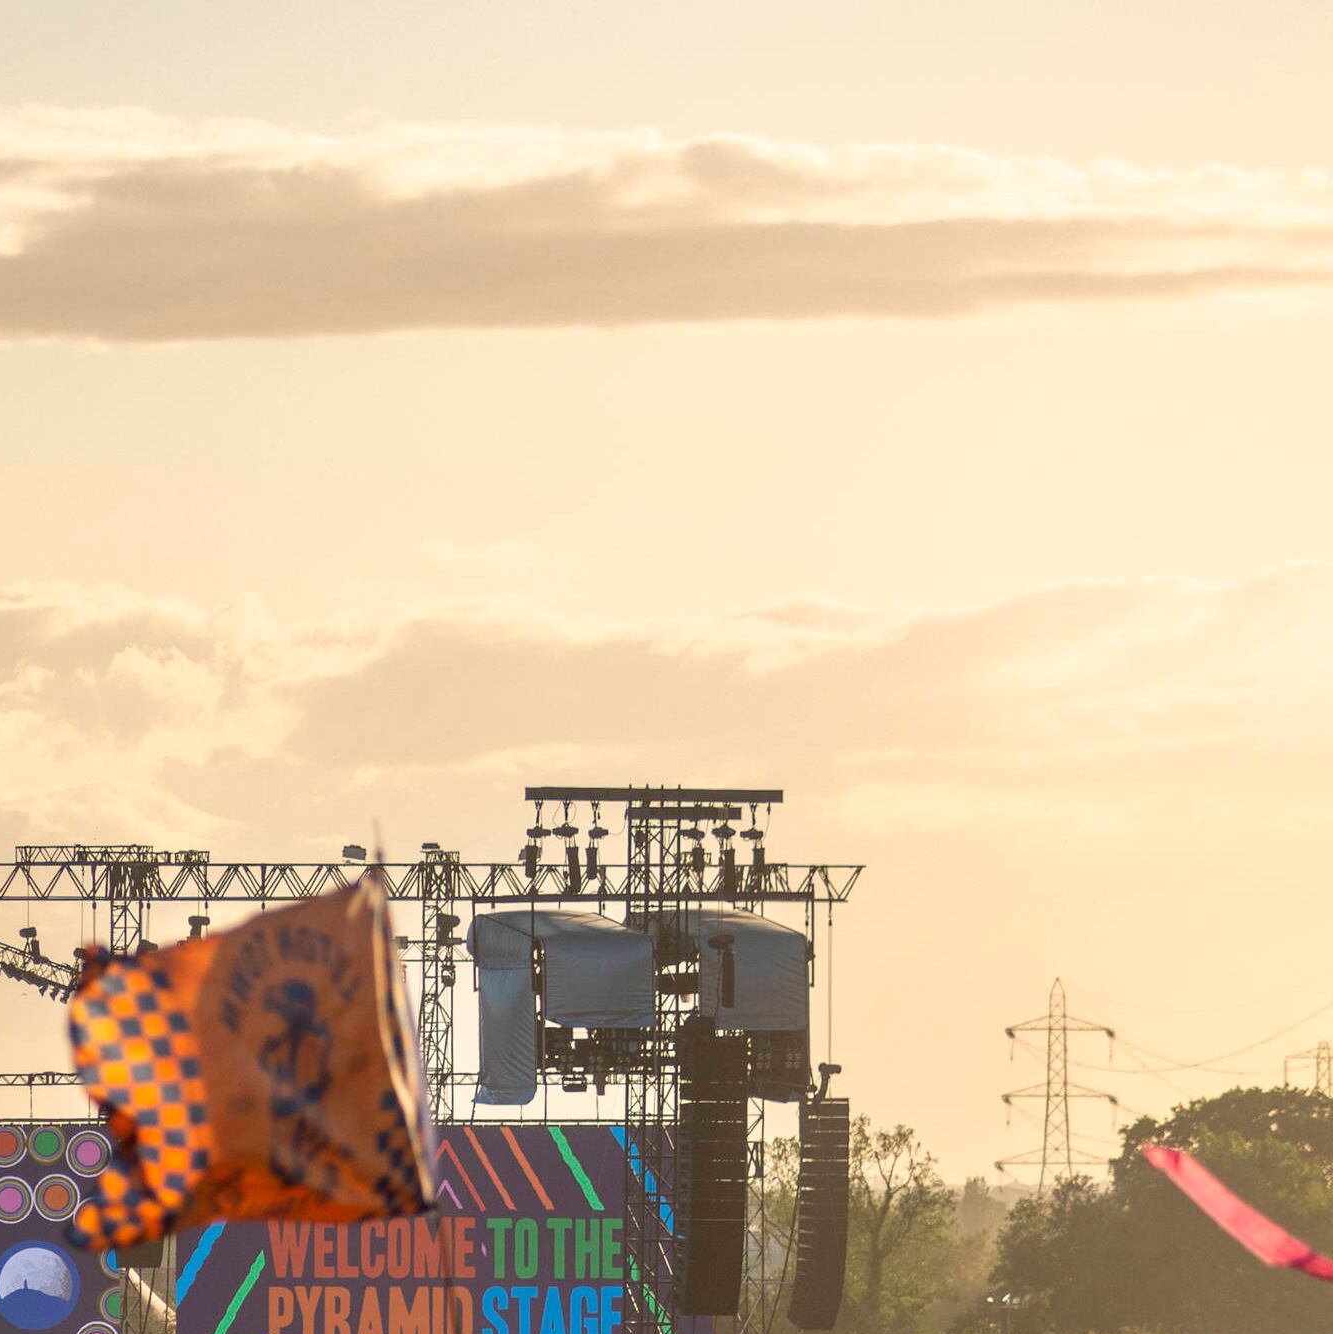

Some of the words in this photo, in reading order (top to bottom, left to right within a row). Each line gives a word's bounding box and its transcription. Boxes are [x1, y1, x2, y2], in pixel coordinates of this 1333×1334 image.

[268, 1217, 476, 1279] WELCOME
[486, 1217, 538, 1279] TO
[546, 1217, 624, 1279] THE
